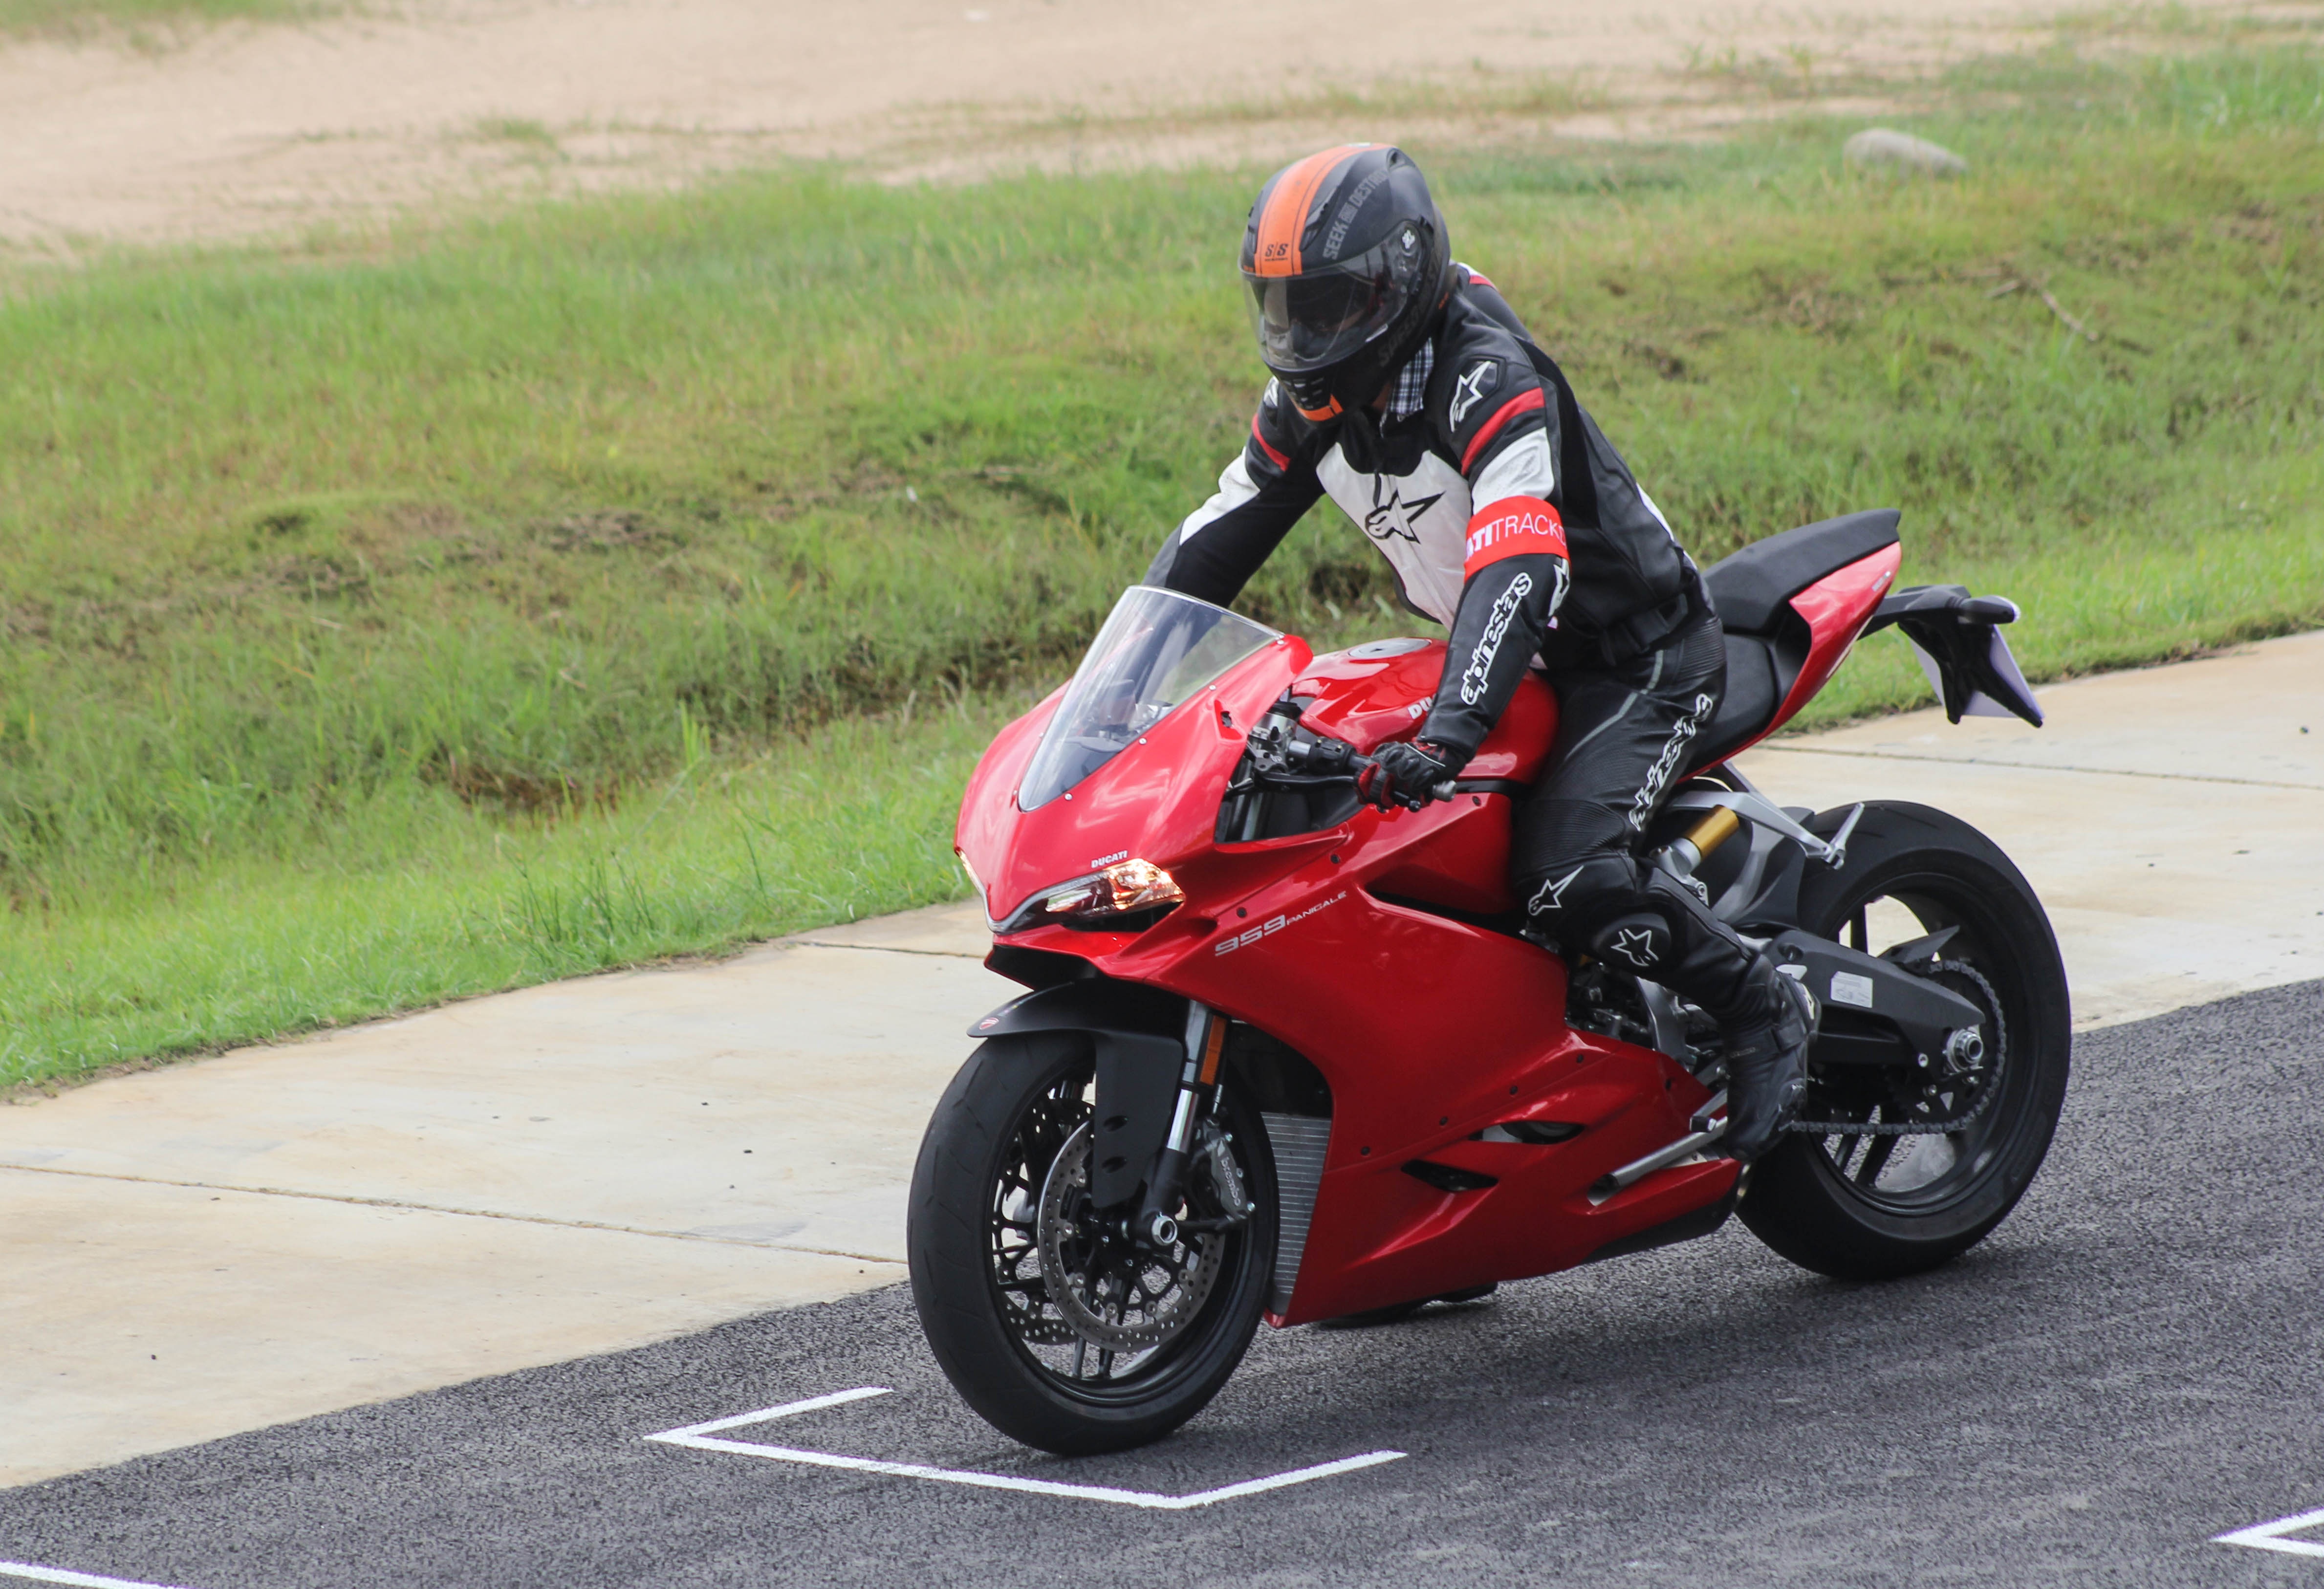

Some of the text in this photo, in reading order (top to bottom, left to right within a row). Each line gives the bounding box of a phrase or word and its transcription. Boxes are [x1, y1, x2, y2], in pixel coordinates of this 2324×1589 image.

[1322, 219, 1349, 260] SEEK
[1460, 571, 1533, 705] alpinestars
[1407, 693, 1436, 720] DU
[1091, 849, 1128, 869] DUCATI
[1215, 890, 1347, 957] 959 PANIGALE
[1220, 1156, 1241, 1207] brembo
